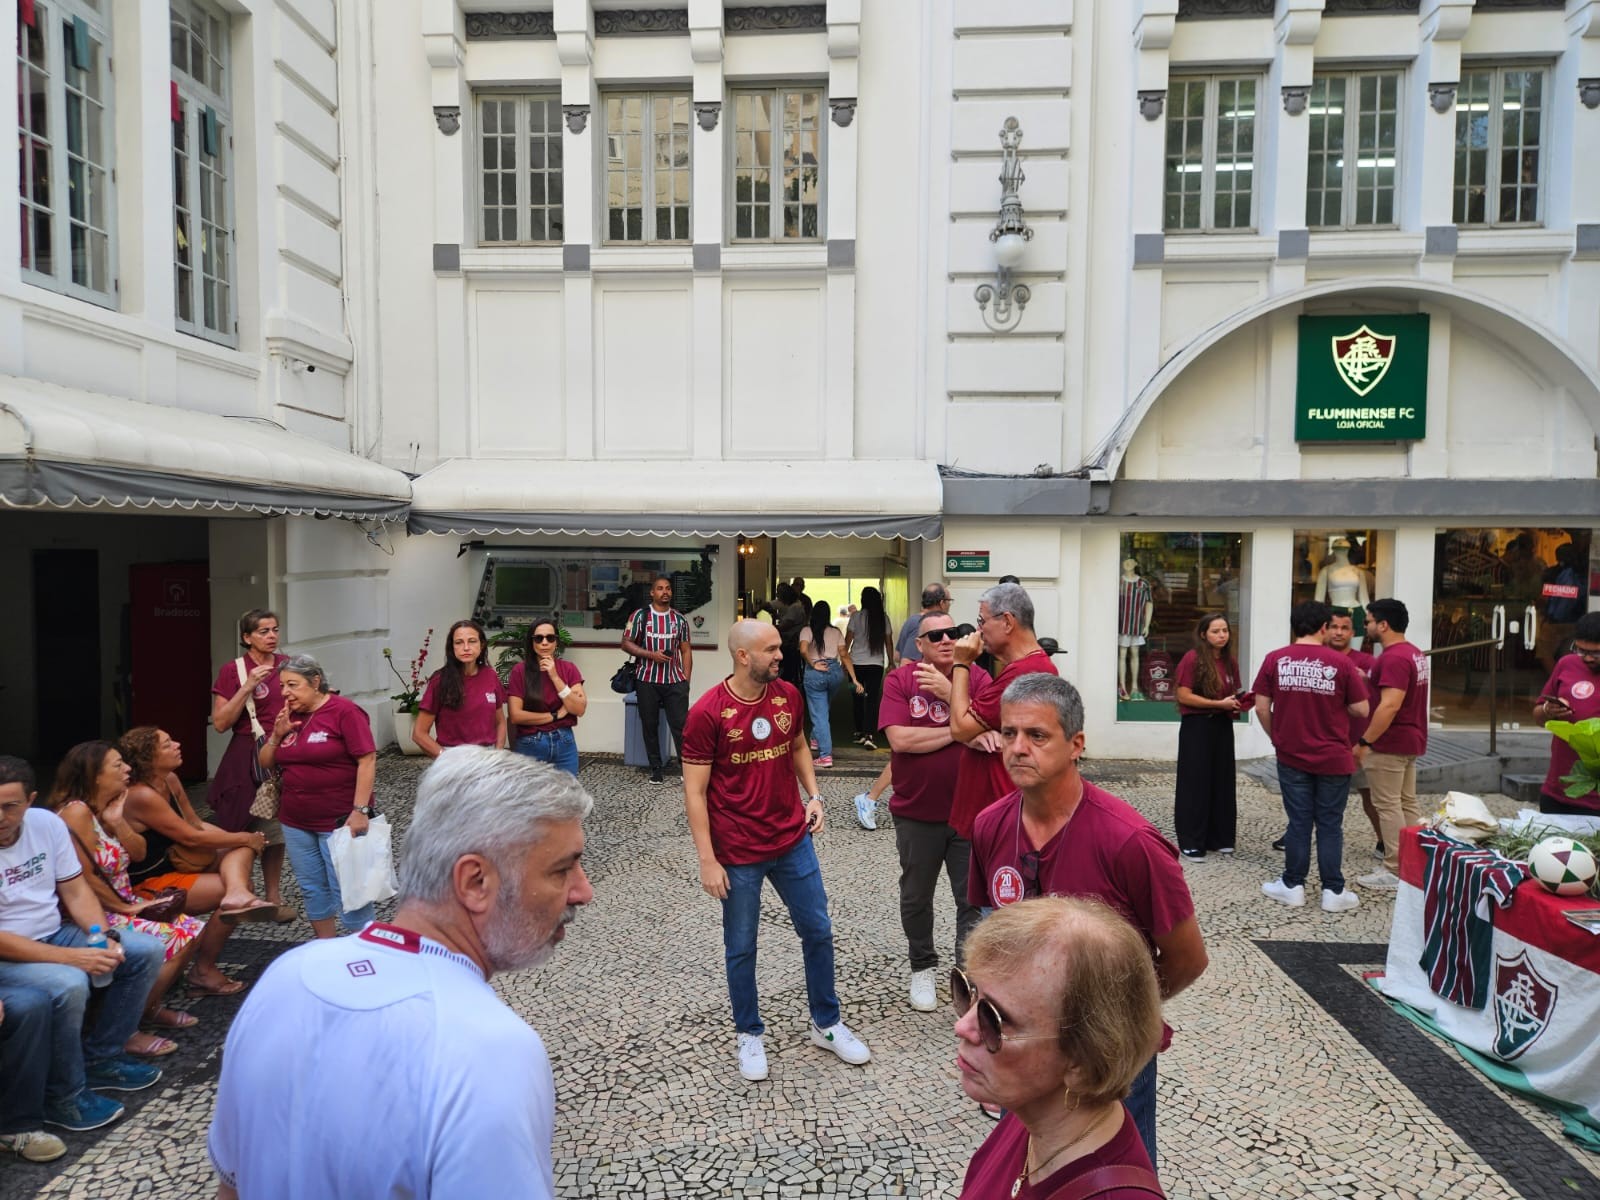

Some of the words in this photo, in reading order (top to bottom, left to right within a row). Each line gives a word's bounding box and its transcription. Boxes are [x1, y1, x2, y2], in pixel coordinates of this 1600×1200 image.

[1308, 407, 1396, 420] FLUMINENSE
[1399, 407, 1415, 419] FC
[1336, 420, 1355, 429] LOJA
[1355, 420, 1385, 429] OFICIAL
[1278, 664, 1323, 678] MATTHEUS
[1278, 676, 1336, 690] MONTENEGRO
[731, 741, 790, 764] SUPERBET
[1001, 873, 1012, 887] 20
